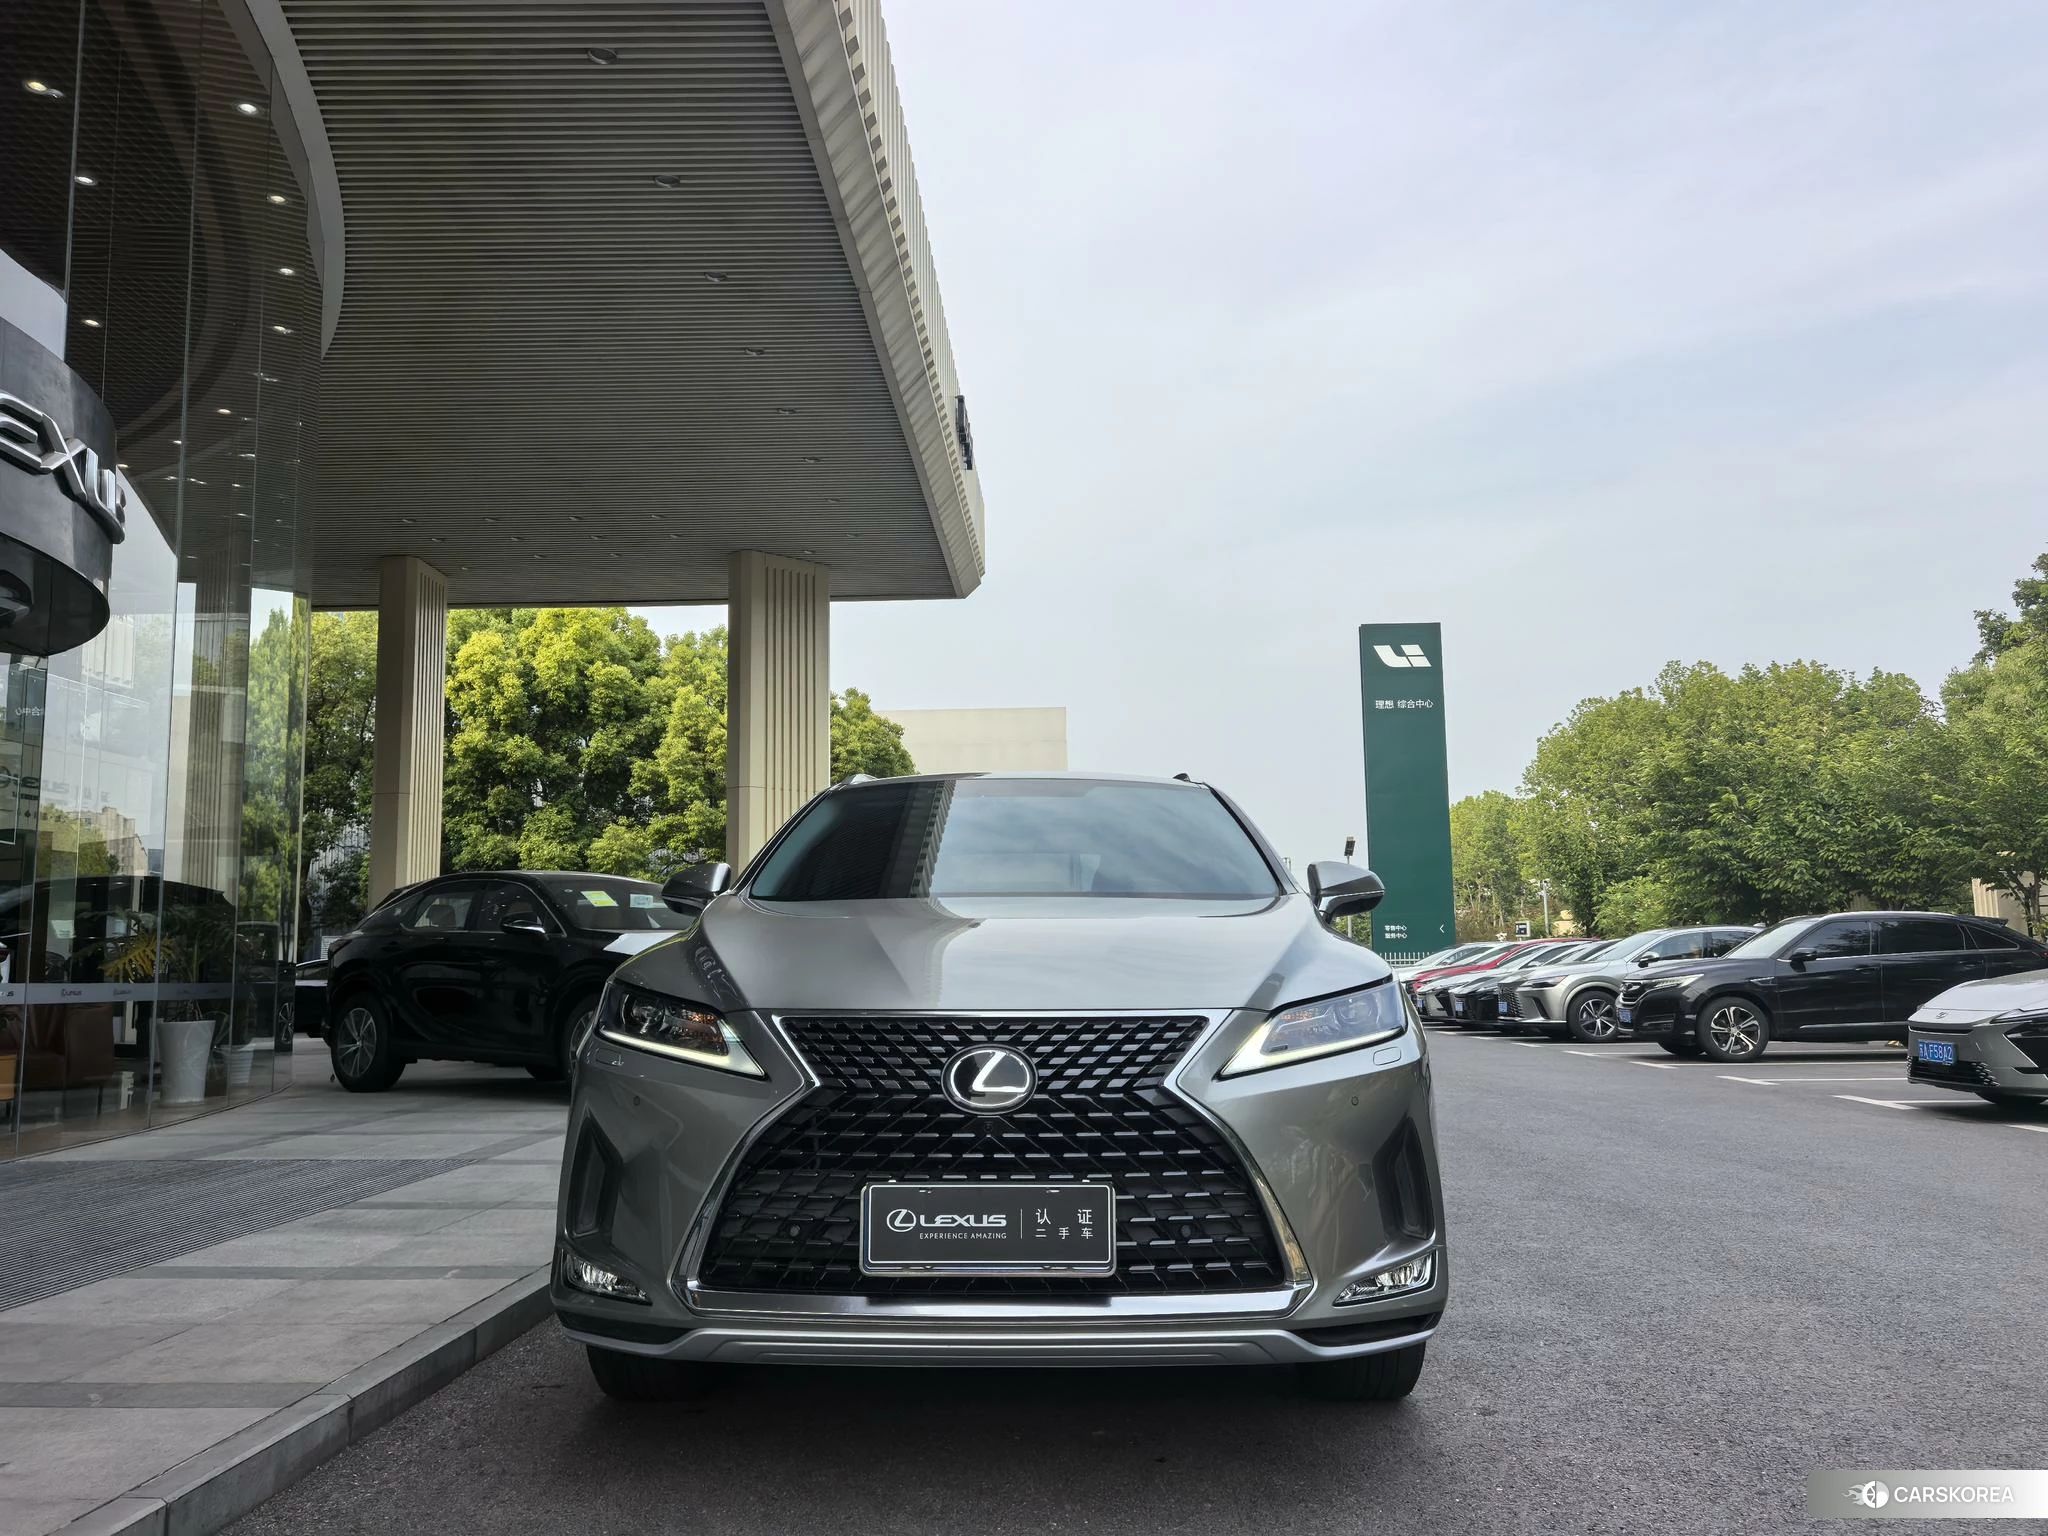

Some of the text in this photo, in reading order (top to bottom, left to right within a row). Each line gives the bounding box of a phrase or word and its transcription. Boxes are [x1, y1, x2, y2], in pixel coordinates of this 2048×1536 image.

[1397, 699, 1434, 710] 综合中心
[919, 1214, 1007, 1228] LEXUS
[919, 1232, 1007, 1240] EXPERIENCE AMAZING
